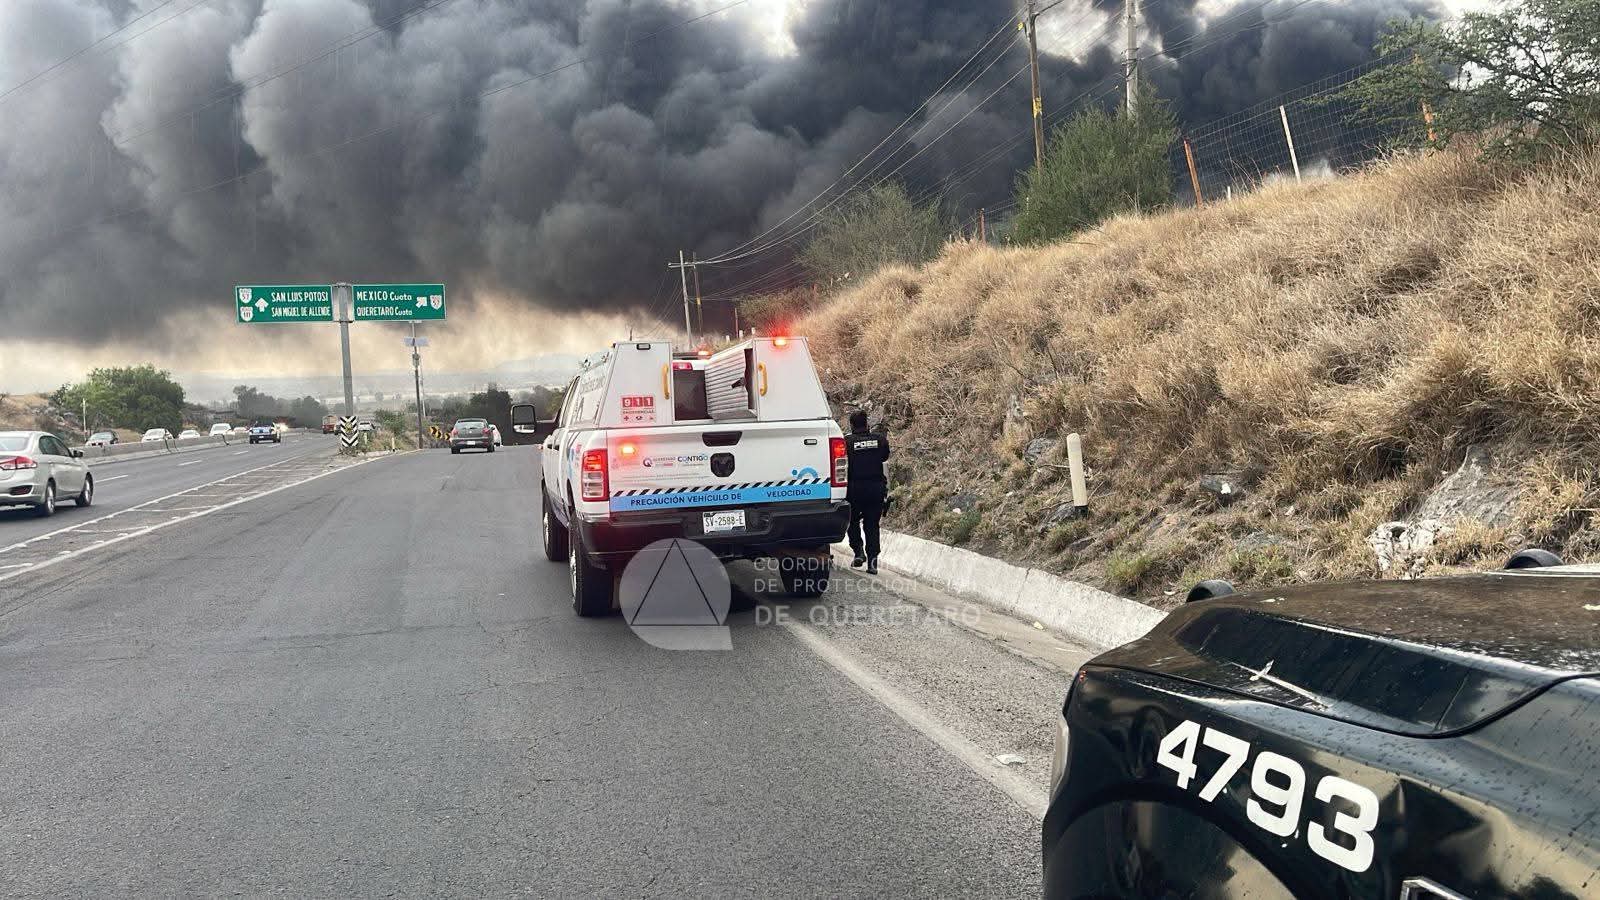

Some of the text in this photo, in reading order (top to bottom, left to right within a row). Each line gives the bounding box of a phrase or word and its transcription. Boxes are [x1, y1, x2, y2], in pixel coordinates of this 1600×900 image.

[271, 292, 286, 302] SAN
[287, 292, 302, 302] LUIS
[356, 291, 388, 300] MEXICO
[271, 306, 331, 317] SAN MIGUEL DE ALLENDE
[395, 307, 413, 316] Cuota
[624, 398, 652, 407] 911
[630, 495, 685, 506] PRECAUCIÓN
[731, 492, 742, 500] DE
[766, 489, 812, 498] VELOCIDAD
[1156, 719, 1379, 873] 4793
